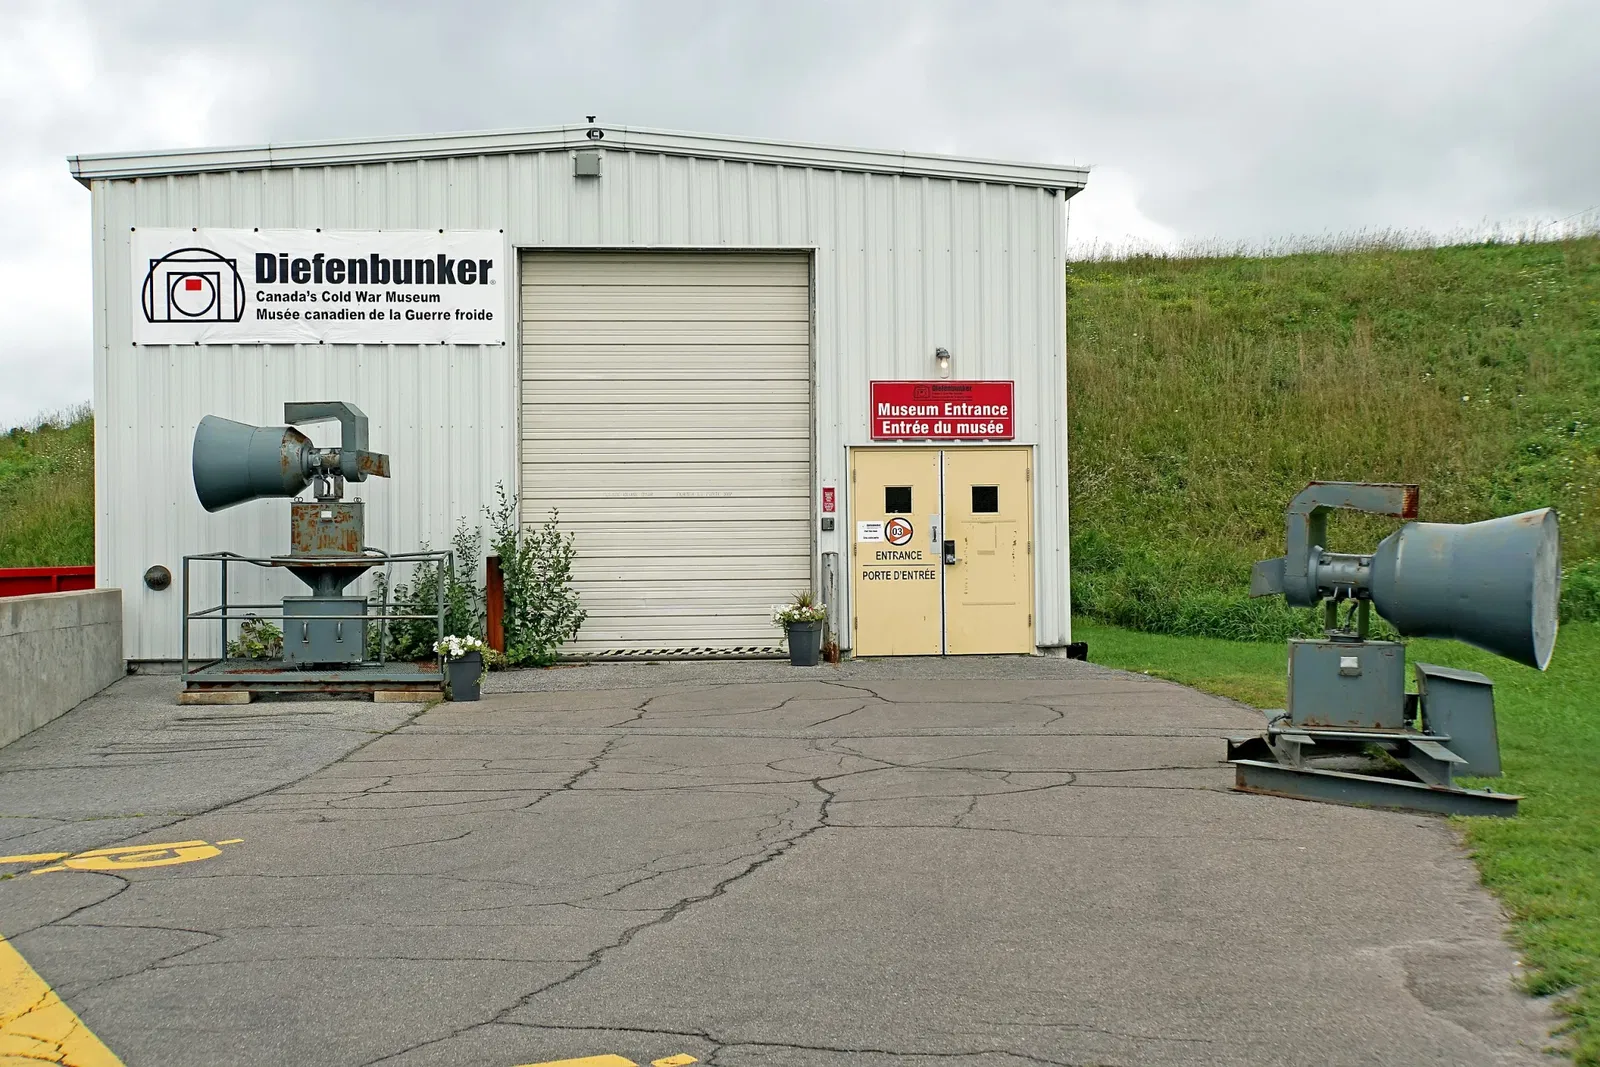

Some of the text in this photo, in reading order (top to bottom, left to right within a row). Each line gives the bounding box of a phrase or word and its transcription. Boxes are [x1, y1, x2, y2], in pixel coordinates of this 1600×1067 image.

[256, 290, 441, 303] Canada's Cold War Museum
[256, 308, 493, 321] Musée canadien de la Guerre froide
[877, 402, 1008, 416] Museum Entrance
[882, 420, 1004, 434] Entrée du musée
[892, 527, 903, 536] 03
[876, 550, 922, 560] ENTRANCE
[862, 568, 936, 580] PORTE D'ENTRÉE
